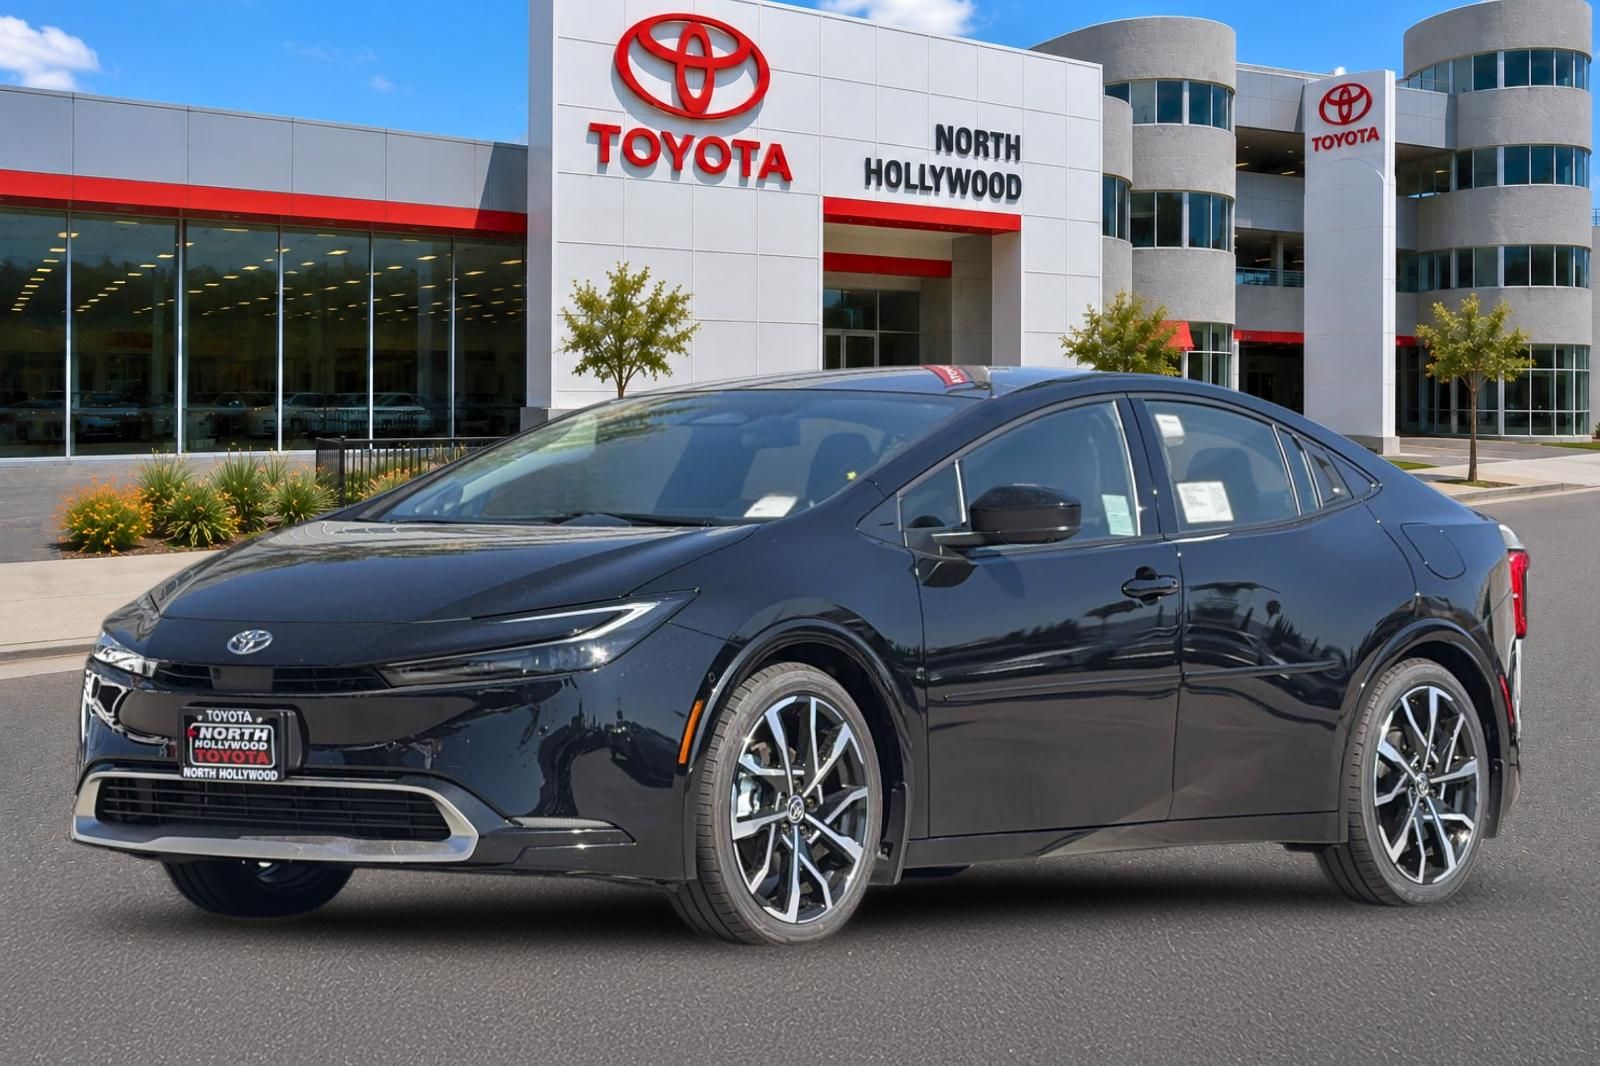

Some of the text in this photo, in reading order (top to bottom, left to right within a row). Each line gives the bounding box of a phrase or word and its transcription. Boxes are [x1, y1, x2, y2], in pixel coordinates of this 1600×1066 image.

[936, 124, 1020, 161] NORTH
[1312, 126, 1379, 152] TOYOTA
[588, 122, 793, 181] TOYOTA
[865, 157, 1021, 200] HOLLYWOOD
[206, 710, 252, 723] TOYOTA
[199, 727, 268, 740] NORTH
[195, 740, 267, 750] HOLLYWOOD
[195, 750, 269, 764] TOYOTA
[184, 768, 278, 780] NORTH HOLLYWOOD
